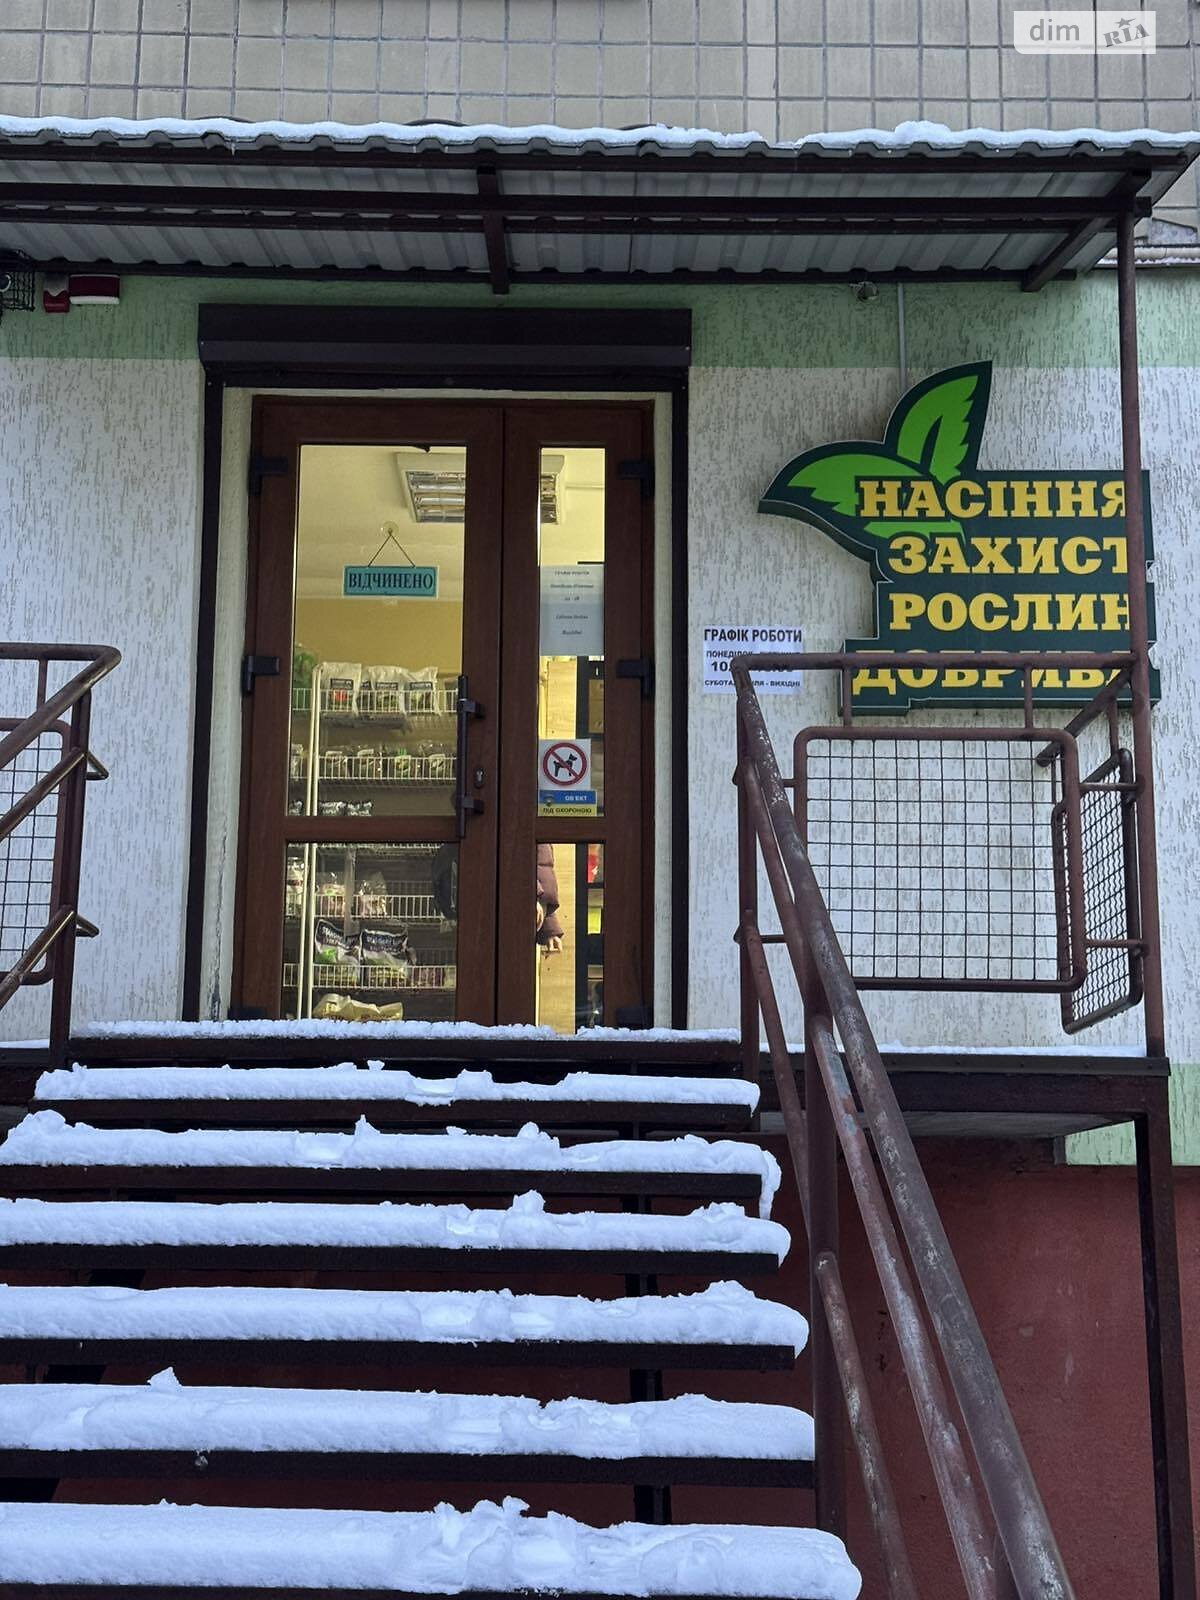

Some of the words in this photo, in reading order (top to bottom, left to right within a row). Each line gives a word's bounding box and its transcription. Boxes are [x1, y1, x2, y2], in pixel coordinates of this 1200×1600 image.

[858, 480, 1126, 518] НАСІННЯ
[888, 536, 1128, 575] ЗАХИСТ
[348, 573, 433, 590] ВІДЧИНЕНО
[888, 592, 1130, 631] РОСЛИН
[704, 628, 749, 642] ГРАФІК
[752, 629, 802, 642] РОБОТИ
